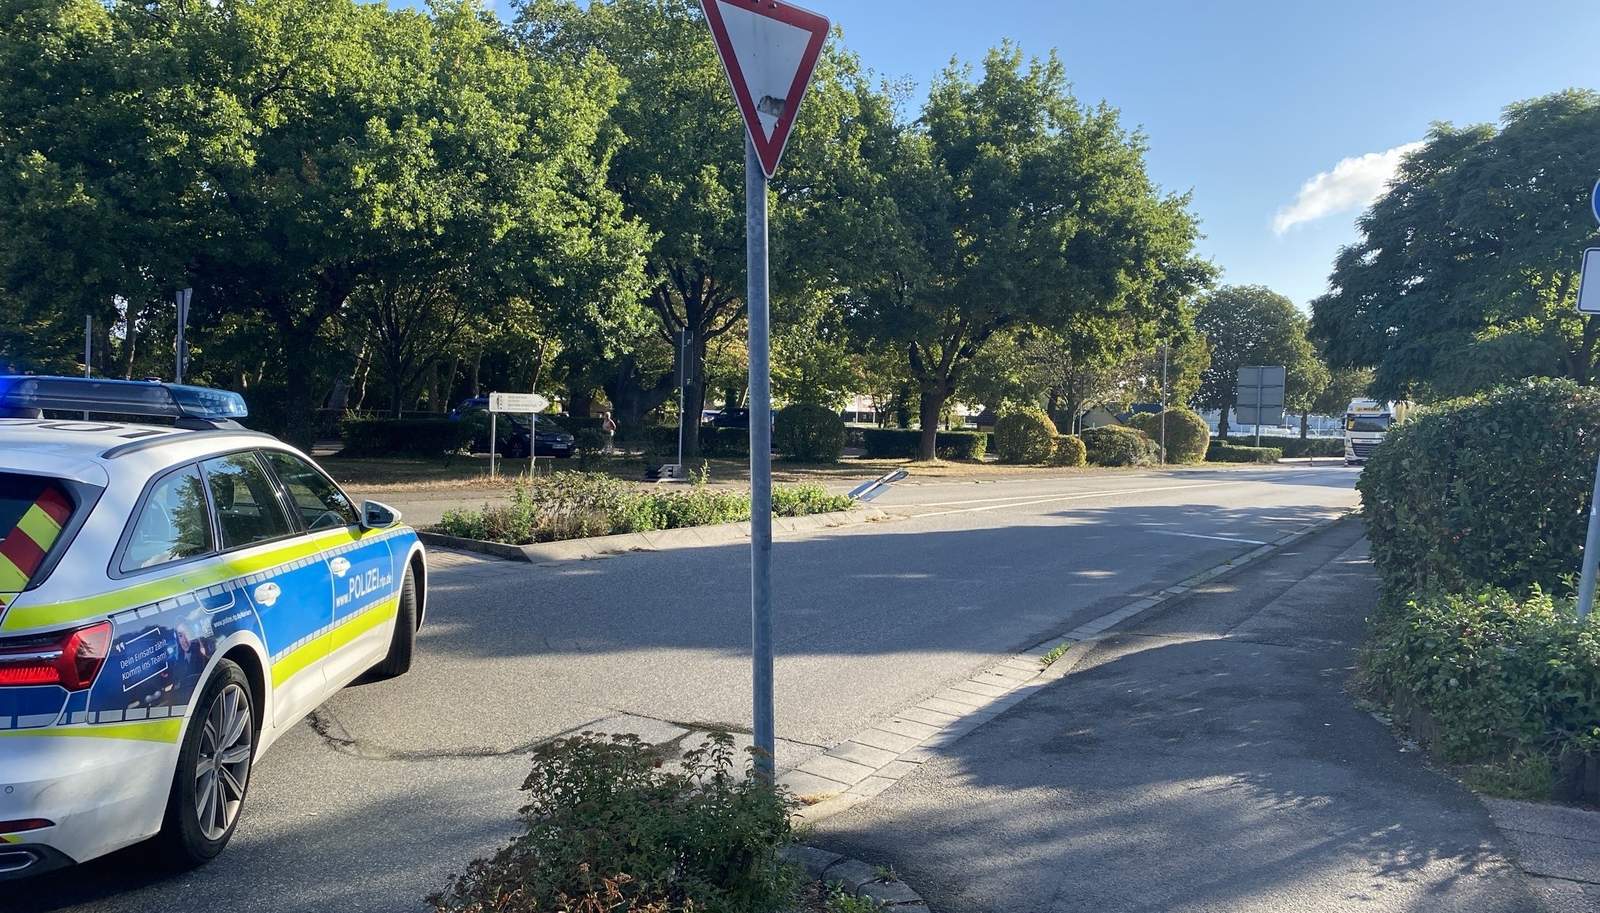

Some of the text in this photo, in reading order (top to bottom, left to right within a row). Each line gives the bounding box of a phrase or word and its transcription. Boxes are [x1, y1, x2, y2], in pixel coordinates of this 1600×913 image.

[120, 656, 134, 669] Dein
[122, 666, 141, 680] Komm
[141, 661, 150, 670] ins
